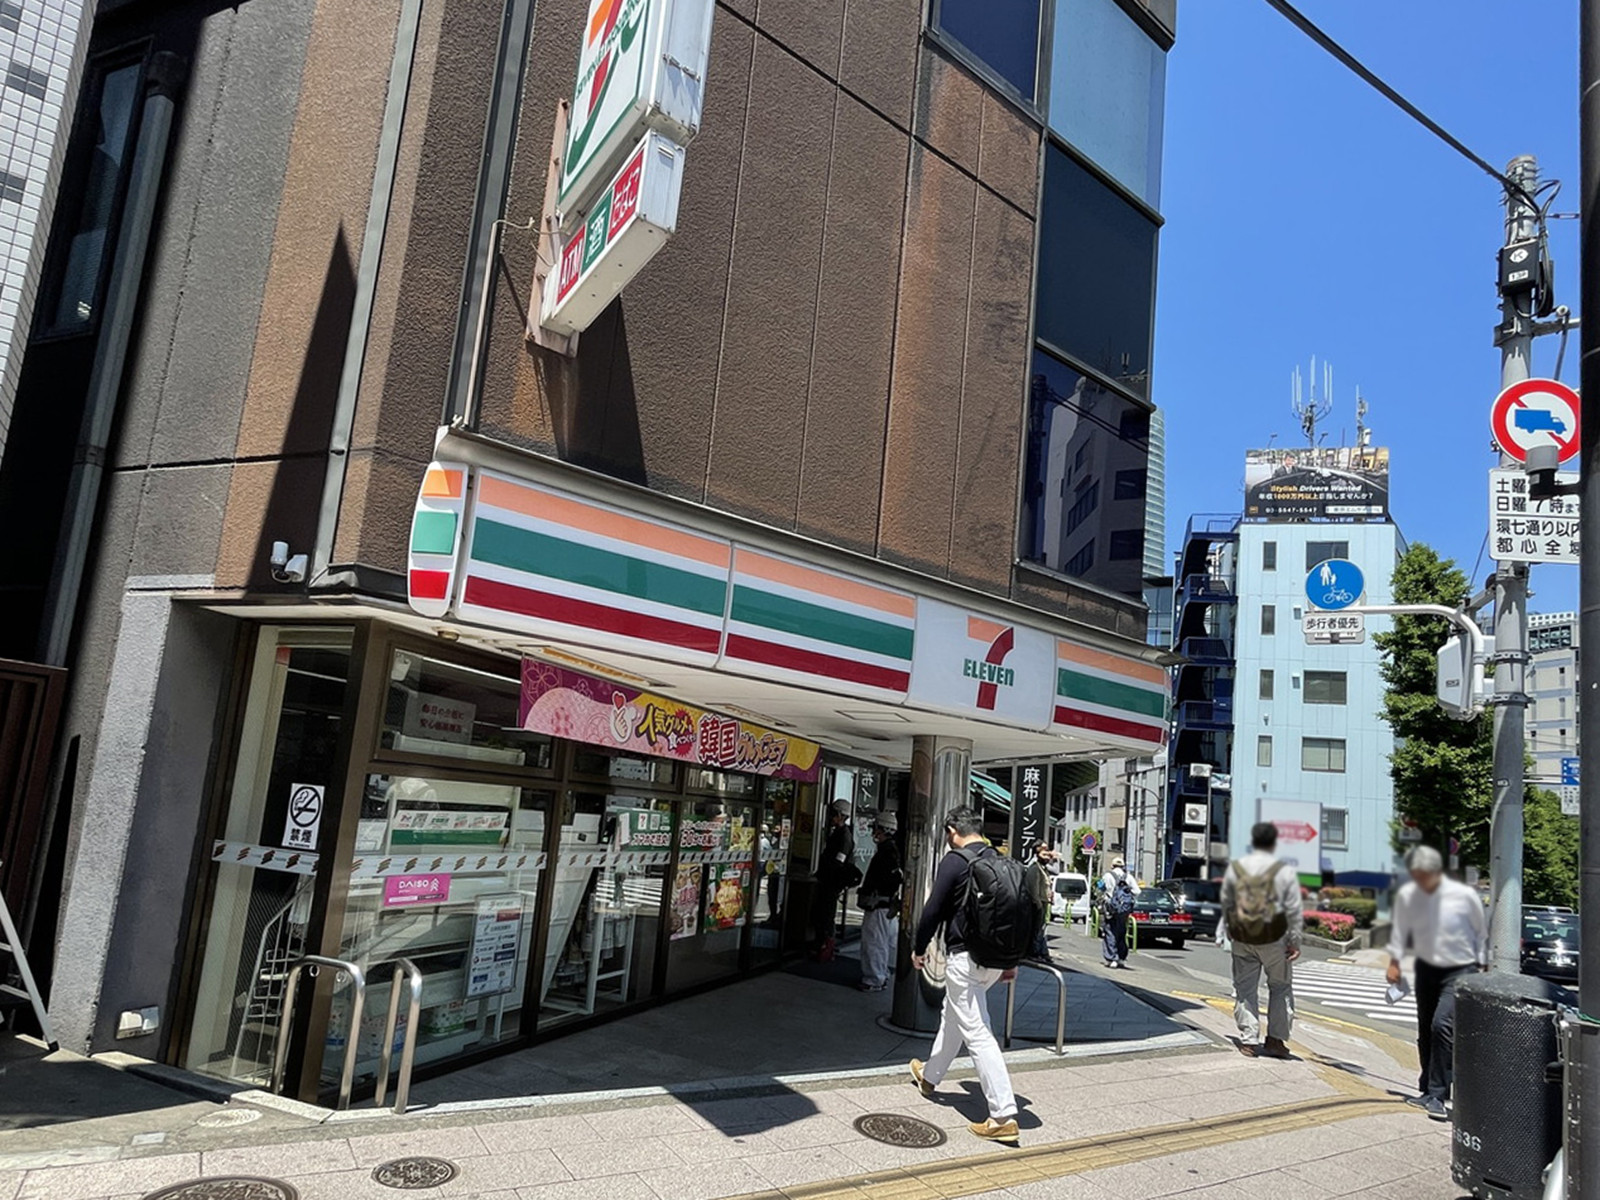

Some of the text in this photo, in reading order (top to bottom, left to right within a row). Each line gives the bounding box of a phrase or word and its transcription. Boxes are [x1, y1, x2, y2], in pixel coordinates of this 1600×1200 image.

[559, 237, 584, 291] ATM
[586, 207, 607, 264] 酒
[1299, 484, 1328, 492] Drivers
[1330, 484, 1362, 492] Wanted
[1306, 617, 1359, 630] 歩行者優先
[967, 615, 1015, 711] 7
[1020, 766, 1041, 867] 麻布インテリ
[289, 828, 313, 844] 禁煙
[398, 879, 429, 889] DAISO
